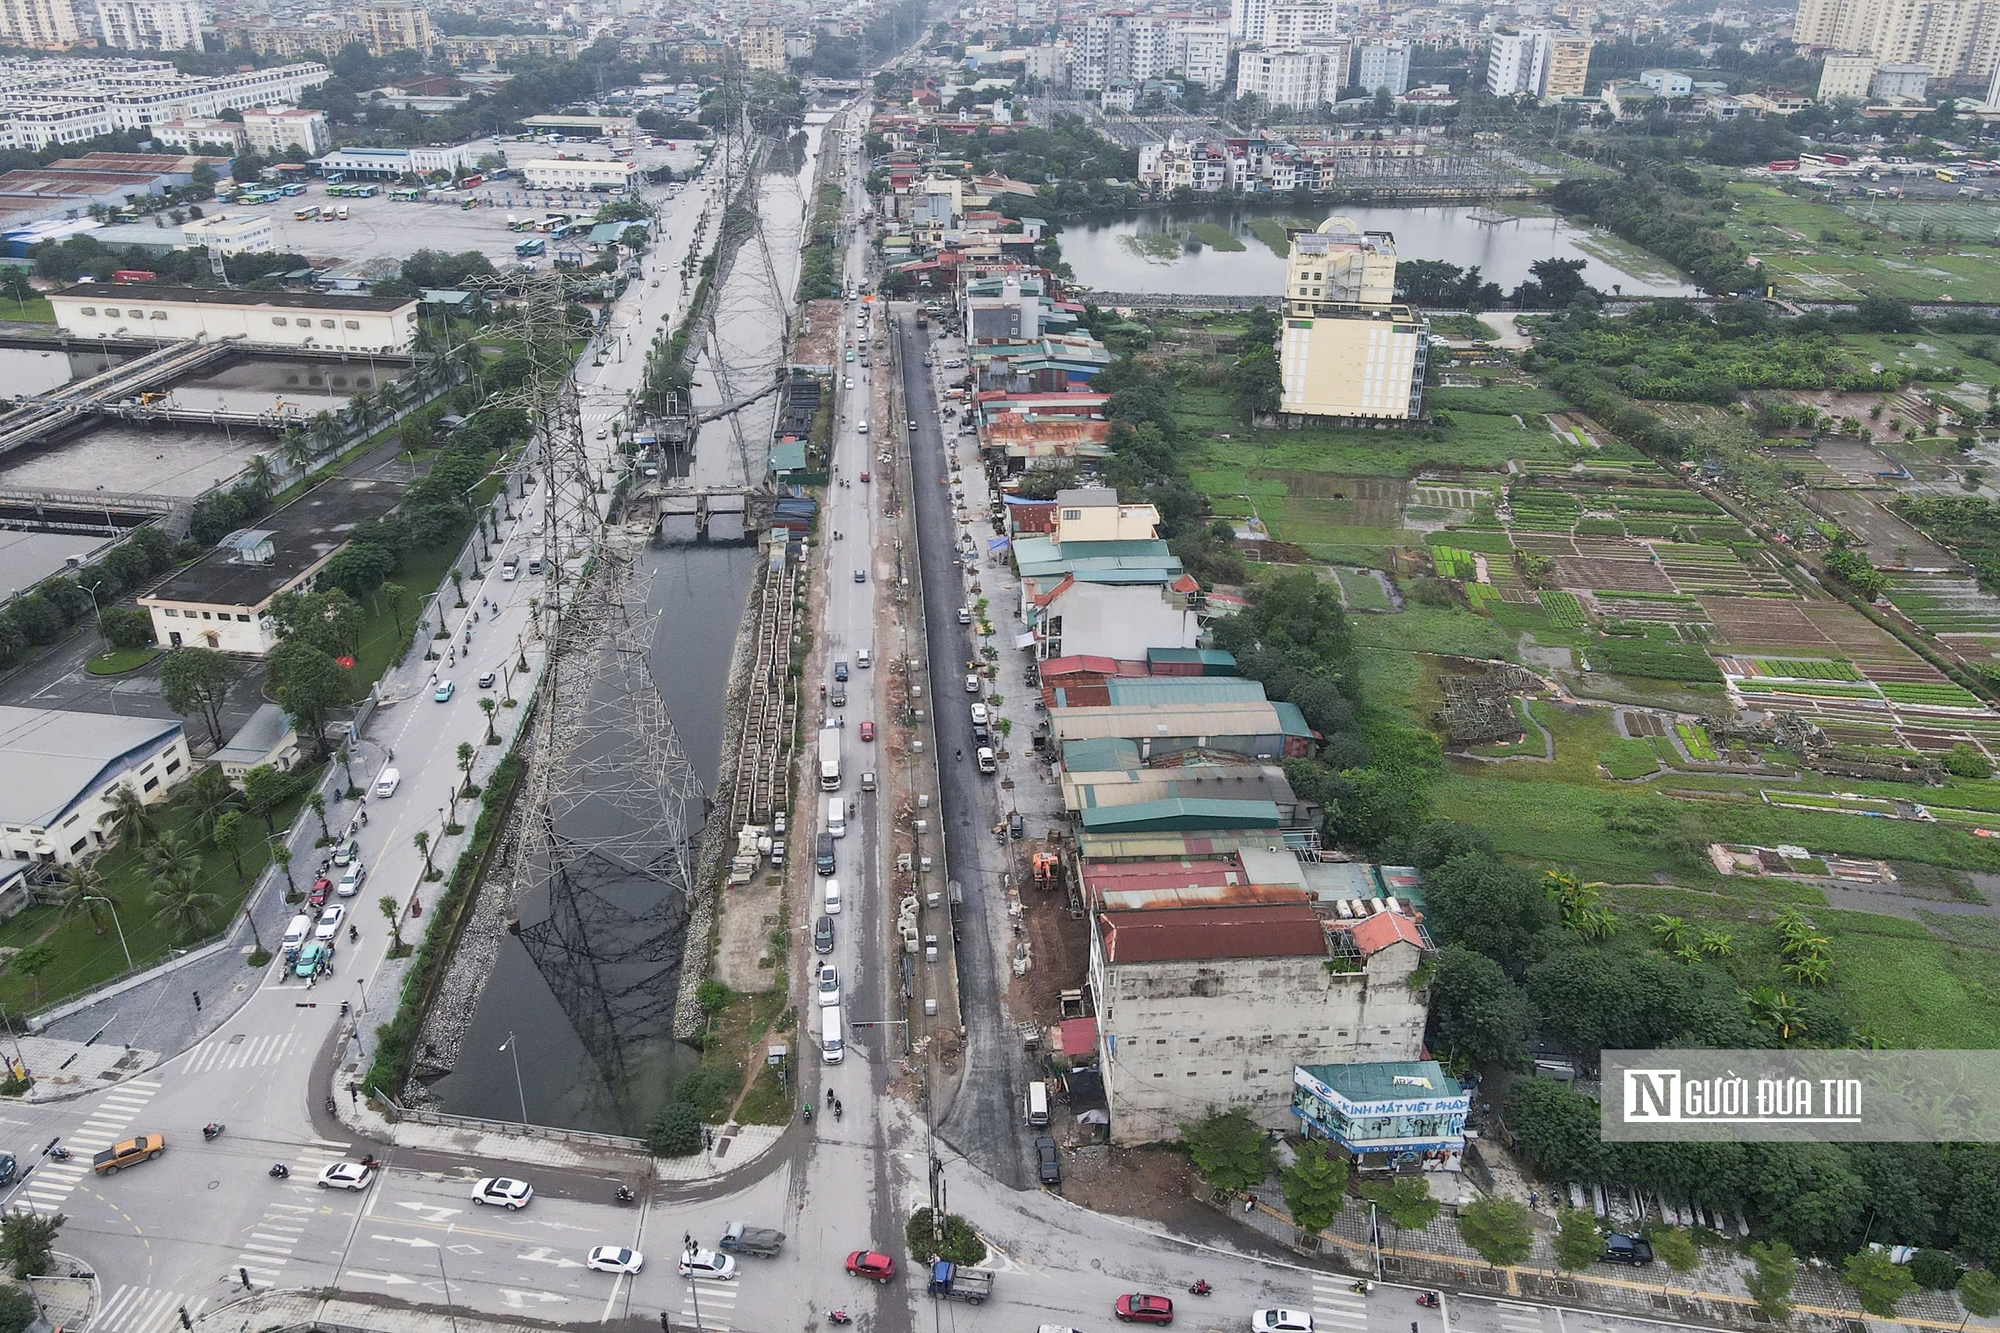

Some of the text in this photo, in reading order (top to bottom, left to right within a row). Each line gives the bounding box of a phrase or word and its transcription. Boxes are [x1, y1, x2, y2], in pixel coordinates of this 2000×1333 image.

[1342, 1099, 1468, 1115] KÍNH MẮT VIỆT PHÁP
